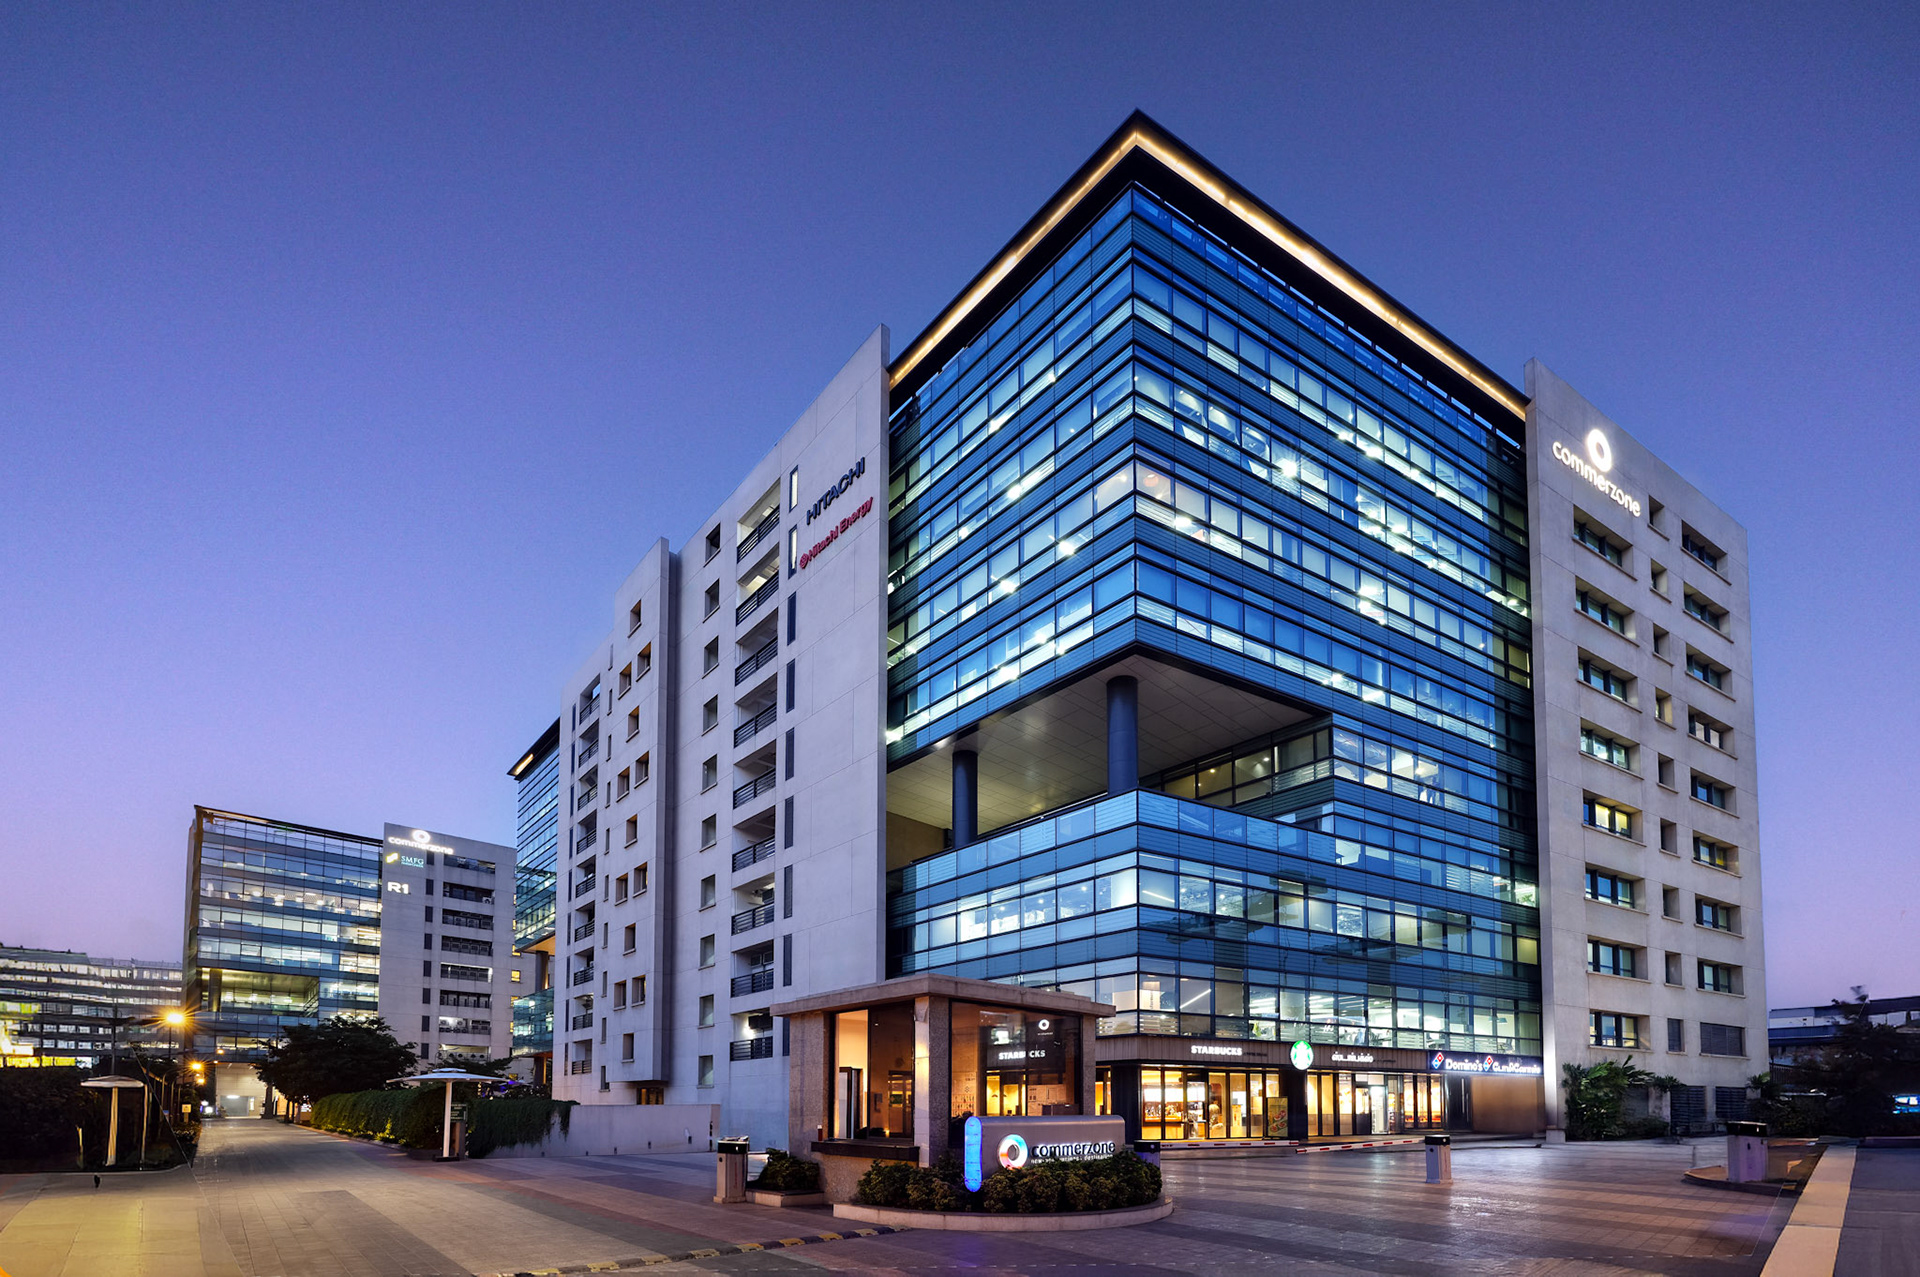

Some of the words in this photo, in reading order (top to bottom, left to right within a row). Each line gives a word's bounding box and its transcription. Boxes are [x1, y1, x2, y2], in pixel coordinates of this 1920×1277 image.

[1552, 441, 1641, 517] commerzone
[806, 457, 865, 525] HITACHI
[808, 525, 839, 561] Hitachi
[840, 496, 874, 534] Energy
[387, 836, 454, 855] commerzone
[401, 855, 425, 866] SMFG
[387, 881, 409, 895] R1
[1191, 1045, 1243, 1056] STARBUCKS
[1445, 1058, 1483, 1072] Domino's
[1031, 1141, 1116, 1157] commerzone
